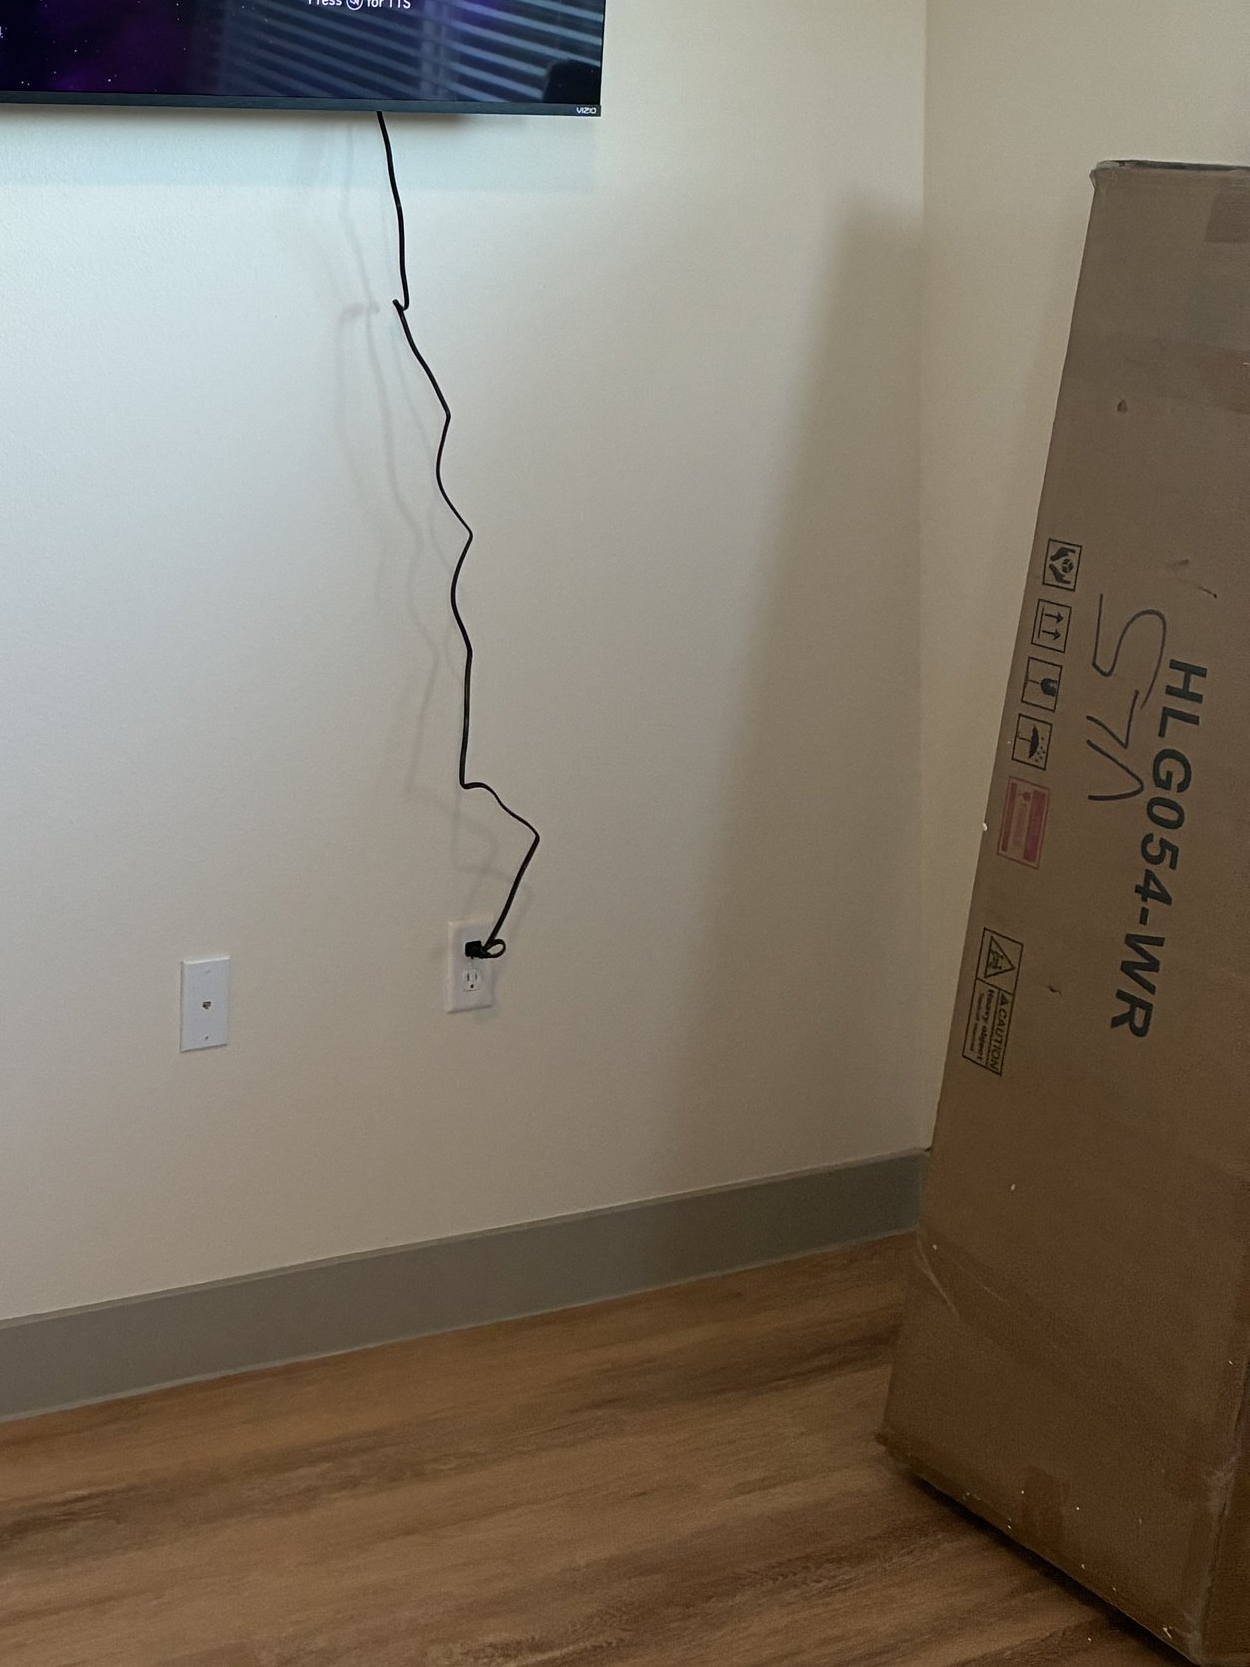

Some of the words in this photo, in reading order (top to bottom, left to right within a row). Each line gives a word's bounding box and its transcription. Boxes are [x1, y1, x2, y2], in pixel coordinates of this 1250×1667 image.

[576, 106, 597, 115] VIZIO
[1109, 658, 1207, 1038] HLG054-WR
[990, 1008, 1008, 1070] CAUTION
